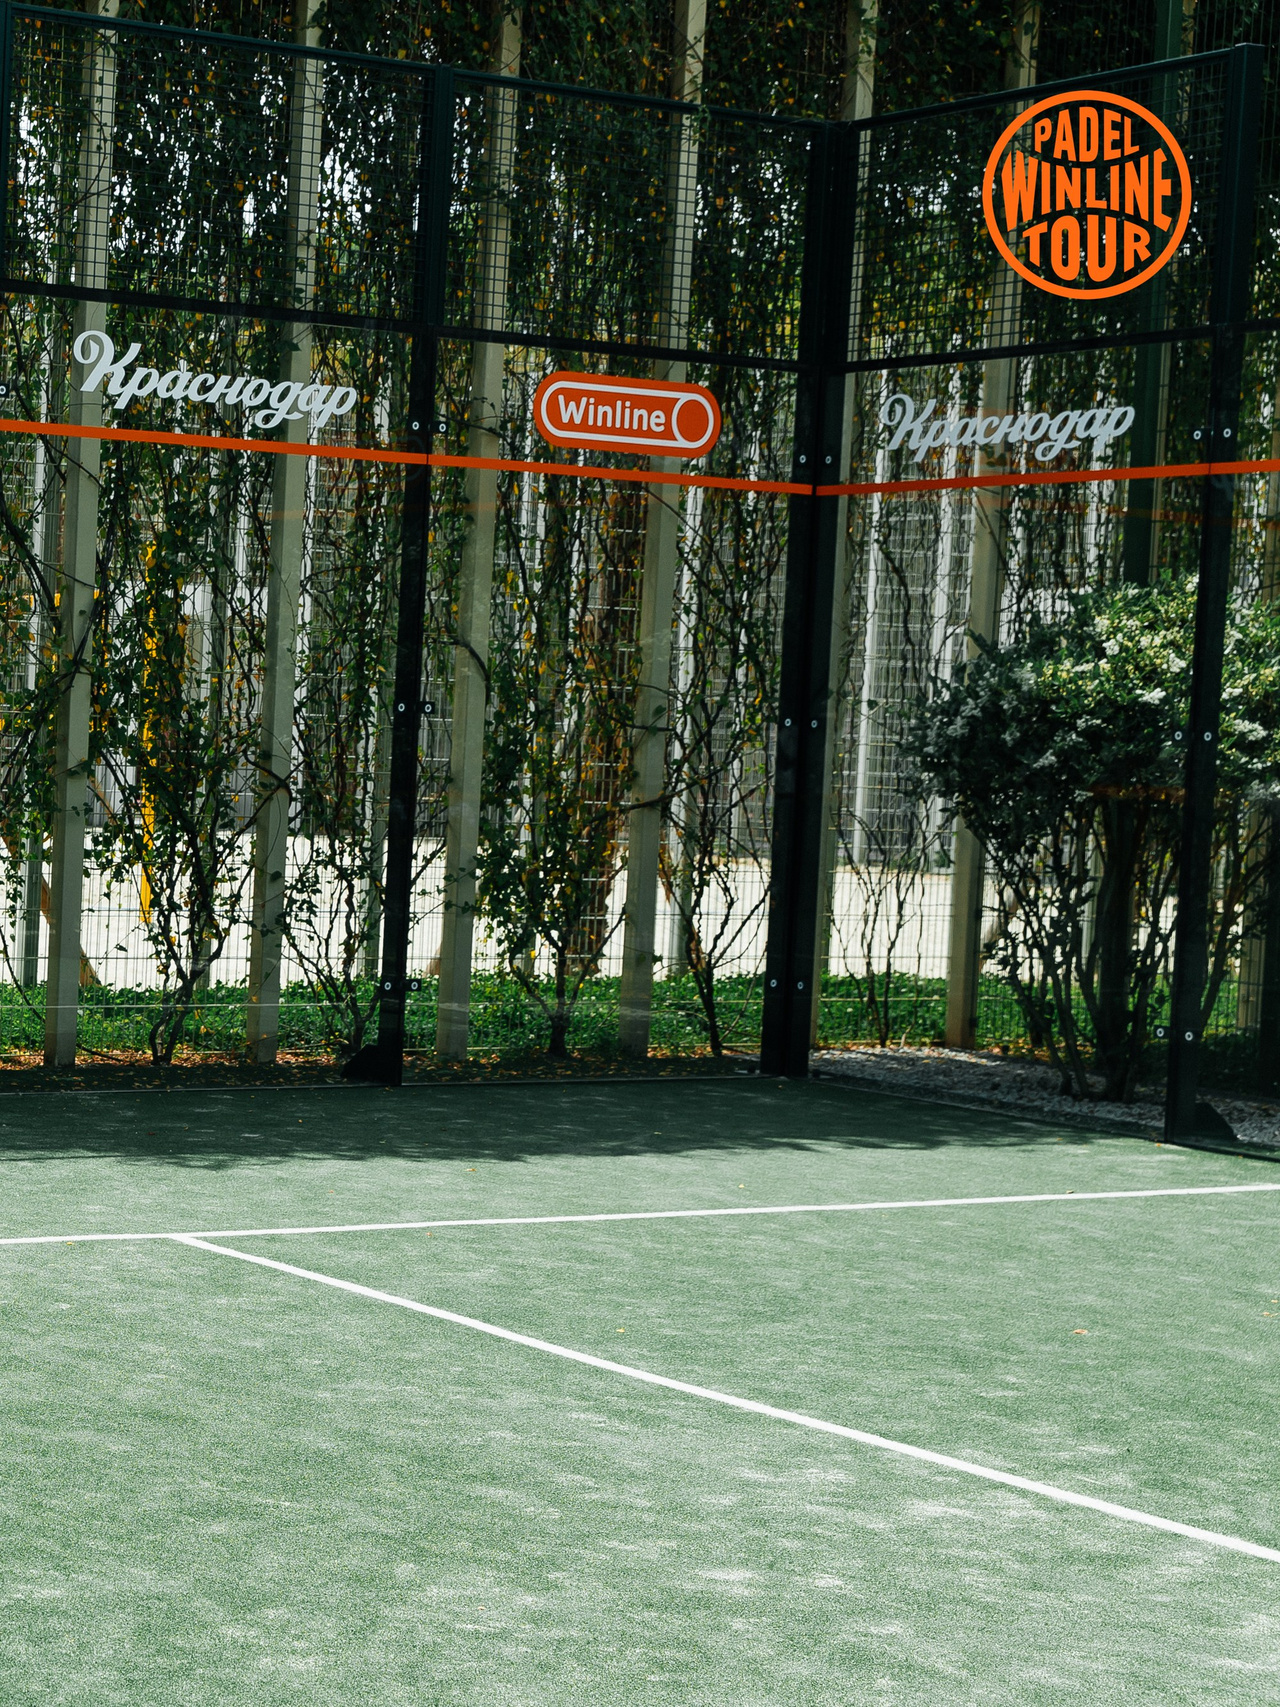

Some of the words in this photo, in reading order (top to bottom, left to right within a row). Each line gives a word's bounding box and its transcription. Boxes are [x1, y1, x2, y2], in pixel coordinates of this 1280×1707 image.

[1034, 106, 1139, 163] PADEL
[1001, 148, 1173, 232] WINLINE
[1022, 215, 1151, 282] TOUR
[72, 330, 357, 429] Краснодар
[557, 394, 666, 433] Winline
[880, 393, 1135, 462] Краснодар
